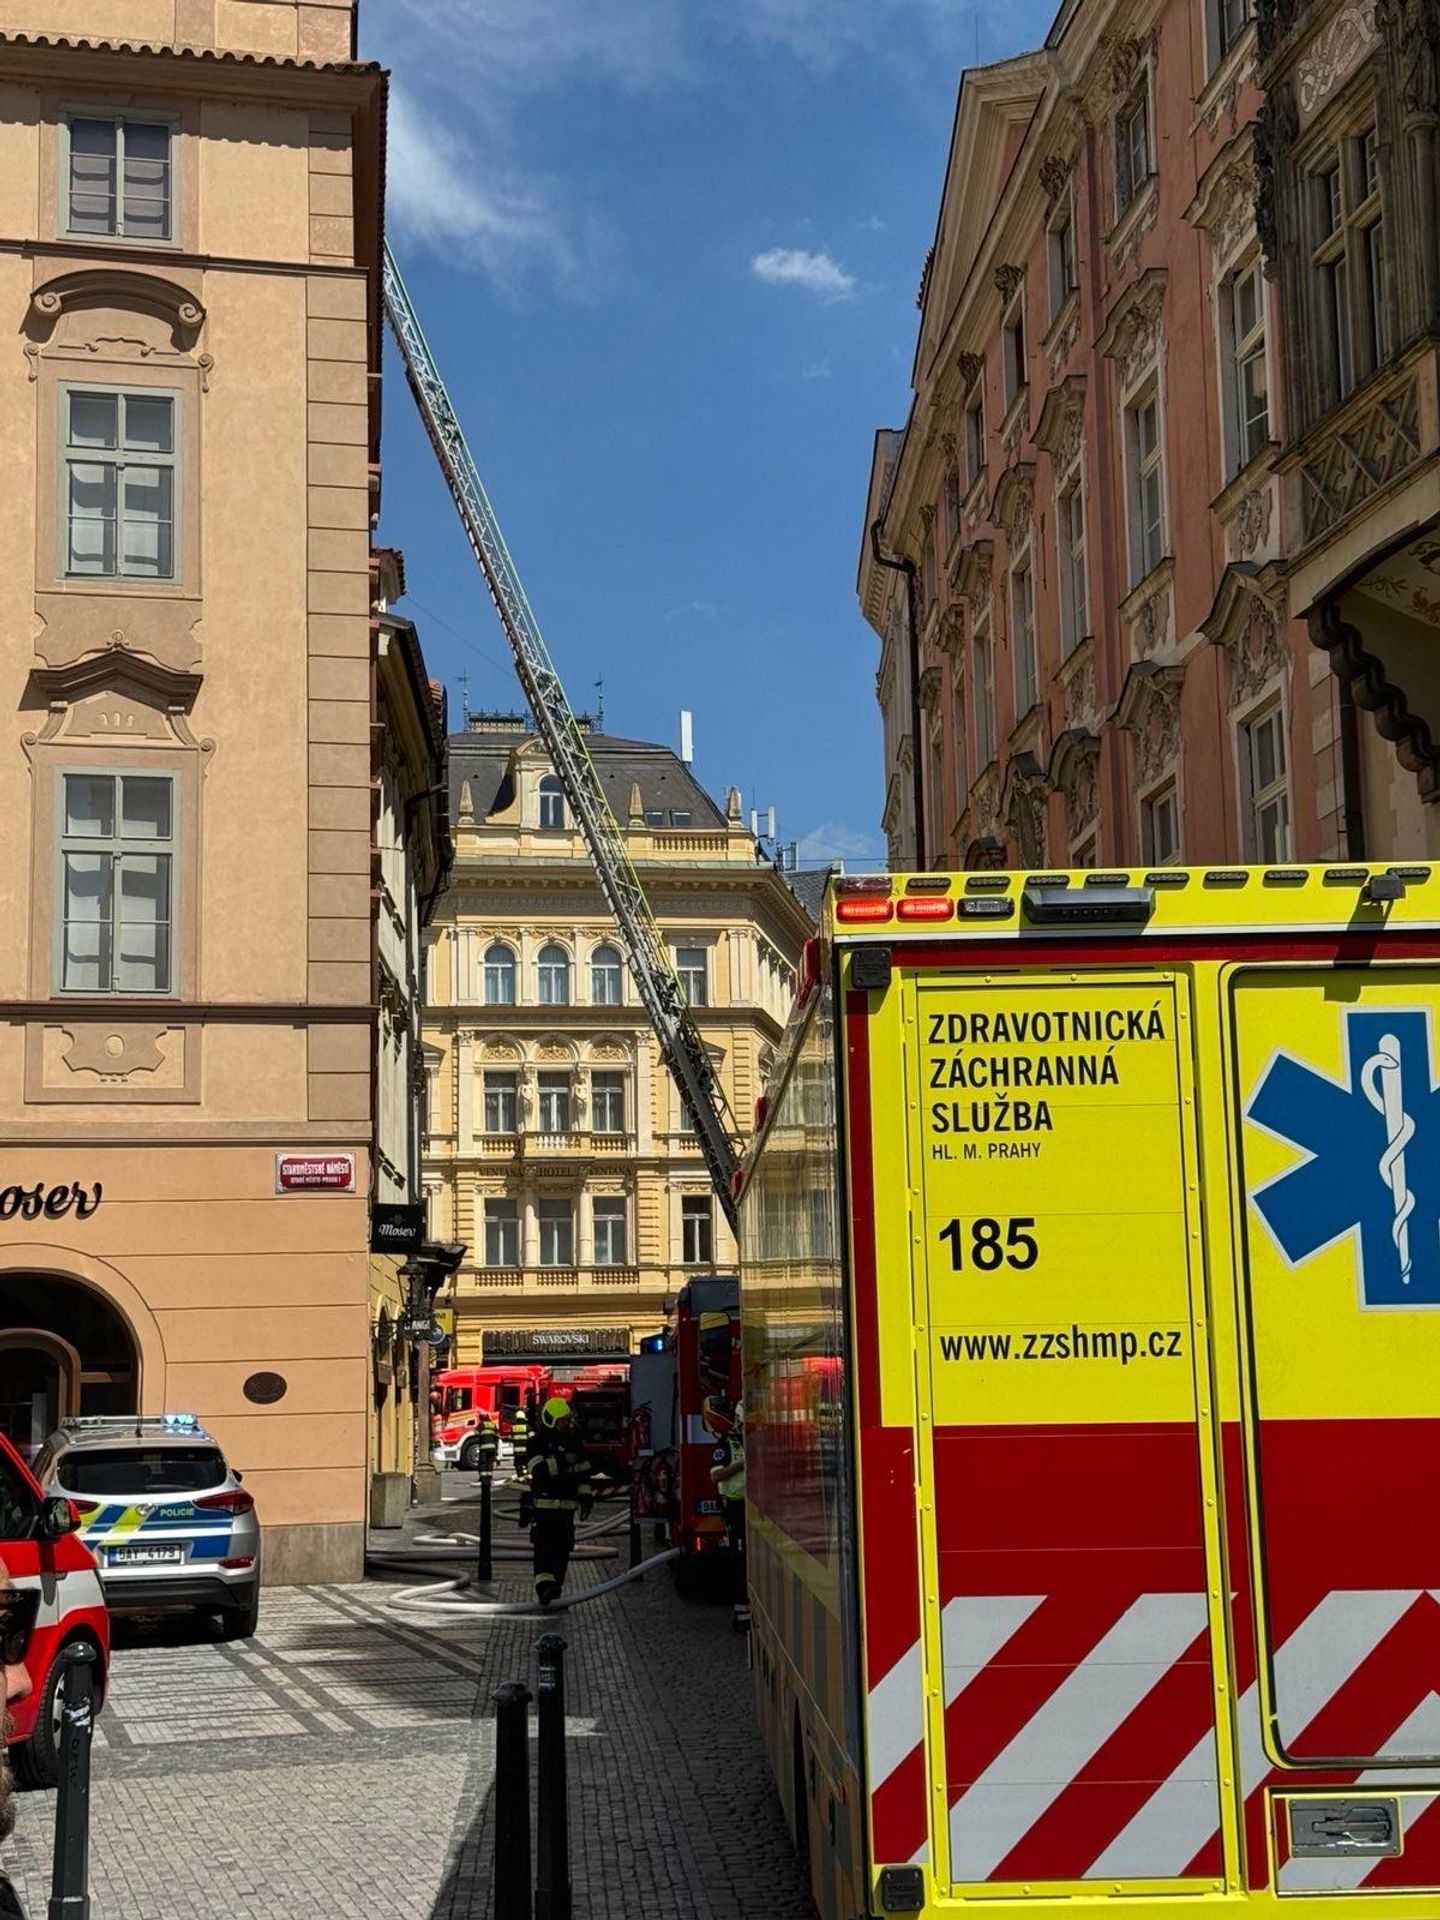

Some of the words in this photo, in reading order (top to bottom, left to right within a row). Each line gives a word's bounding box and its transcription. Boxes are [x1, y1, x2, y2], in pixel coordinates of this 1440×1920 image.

[928, 1001, 1165, 1044] ZDRAVOTNICKÁ
[930, 1046, 1119, 1089] ZÁCHRANNÁ
[931, 1092, 1053, 1133] SLUŽBA
[932, 1144, 958, 1160] HL.
[963, 1143, 983, 1159] M.
[988, 1142, 1041, 1158] PRAHY
[282, 1162, 325, 1175] STAROMĚSTSKÉ
[379, 1223, 416, 1237] Moser
[939, 1217, 1039, 1271] 185
[532, 1334, 589, 1345] SWAROVSKI
[939, 1324, 1182, 1366] www.zzshmp.cz
[160, 1507, 195, 1516] POLICIE
